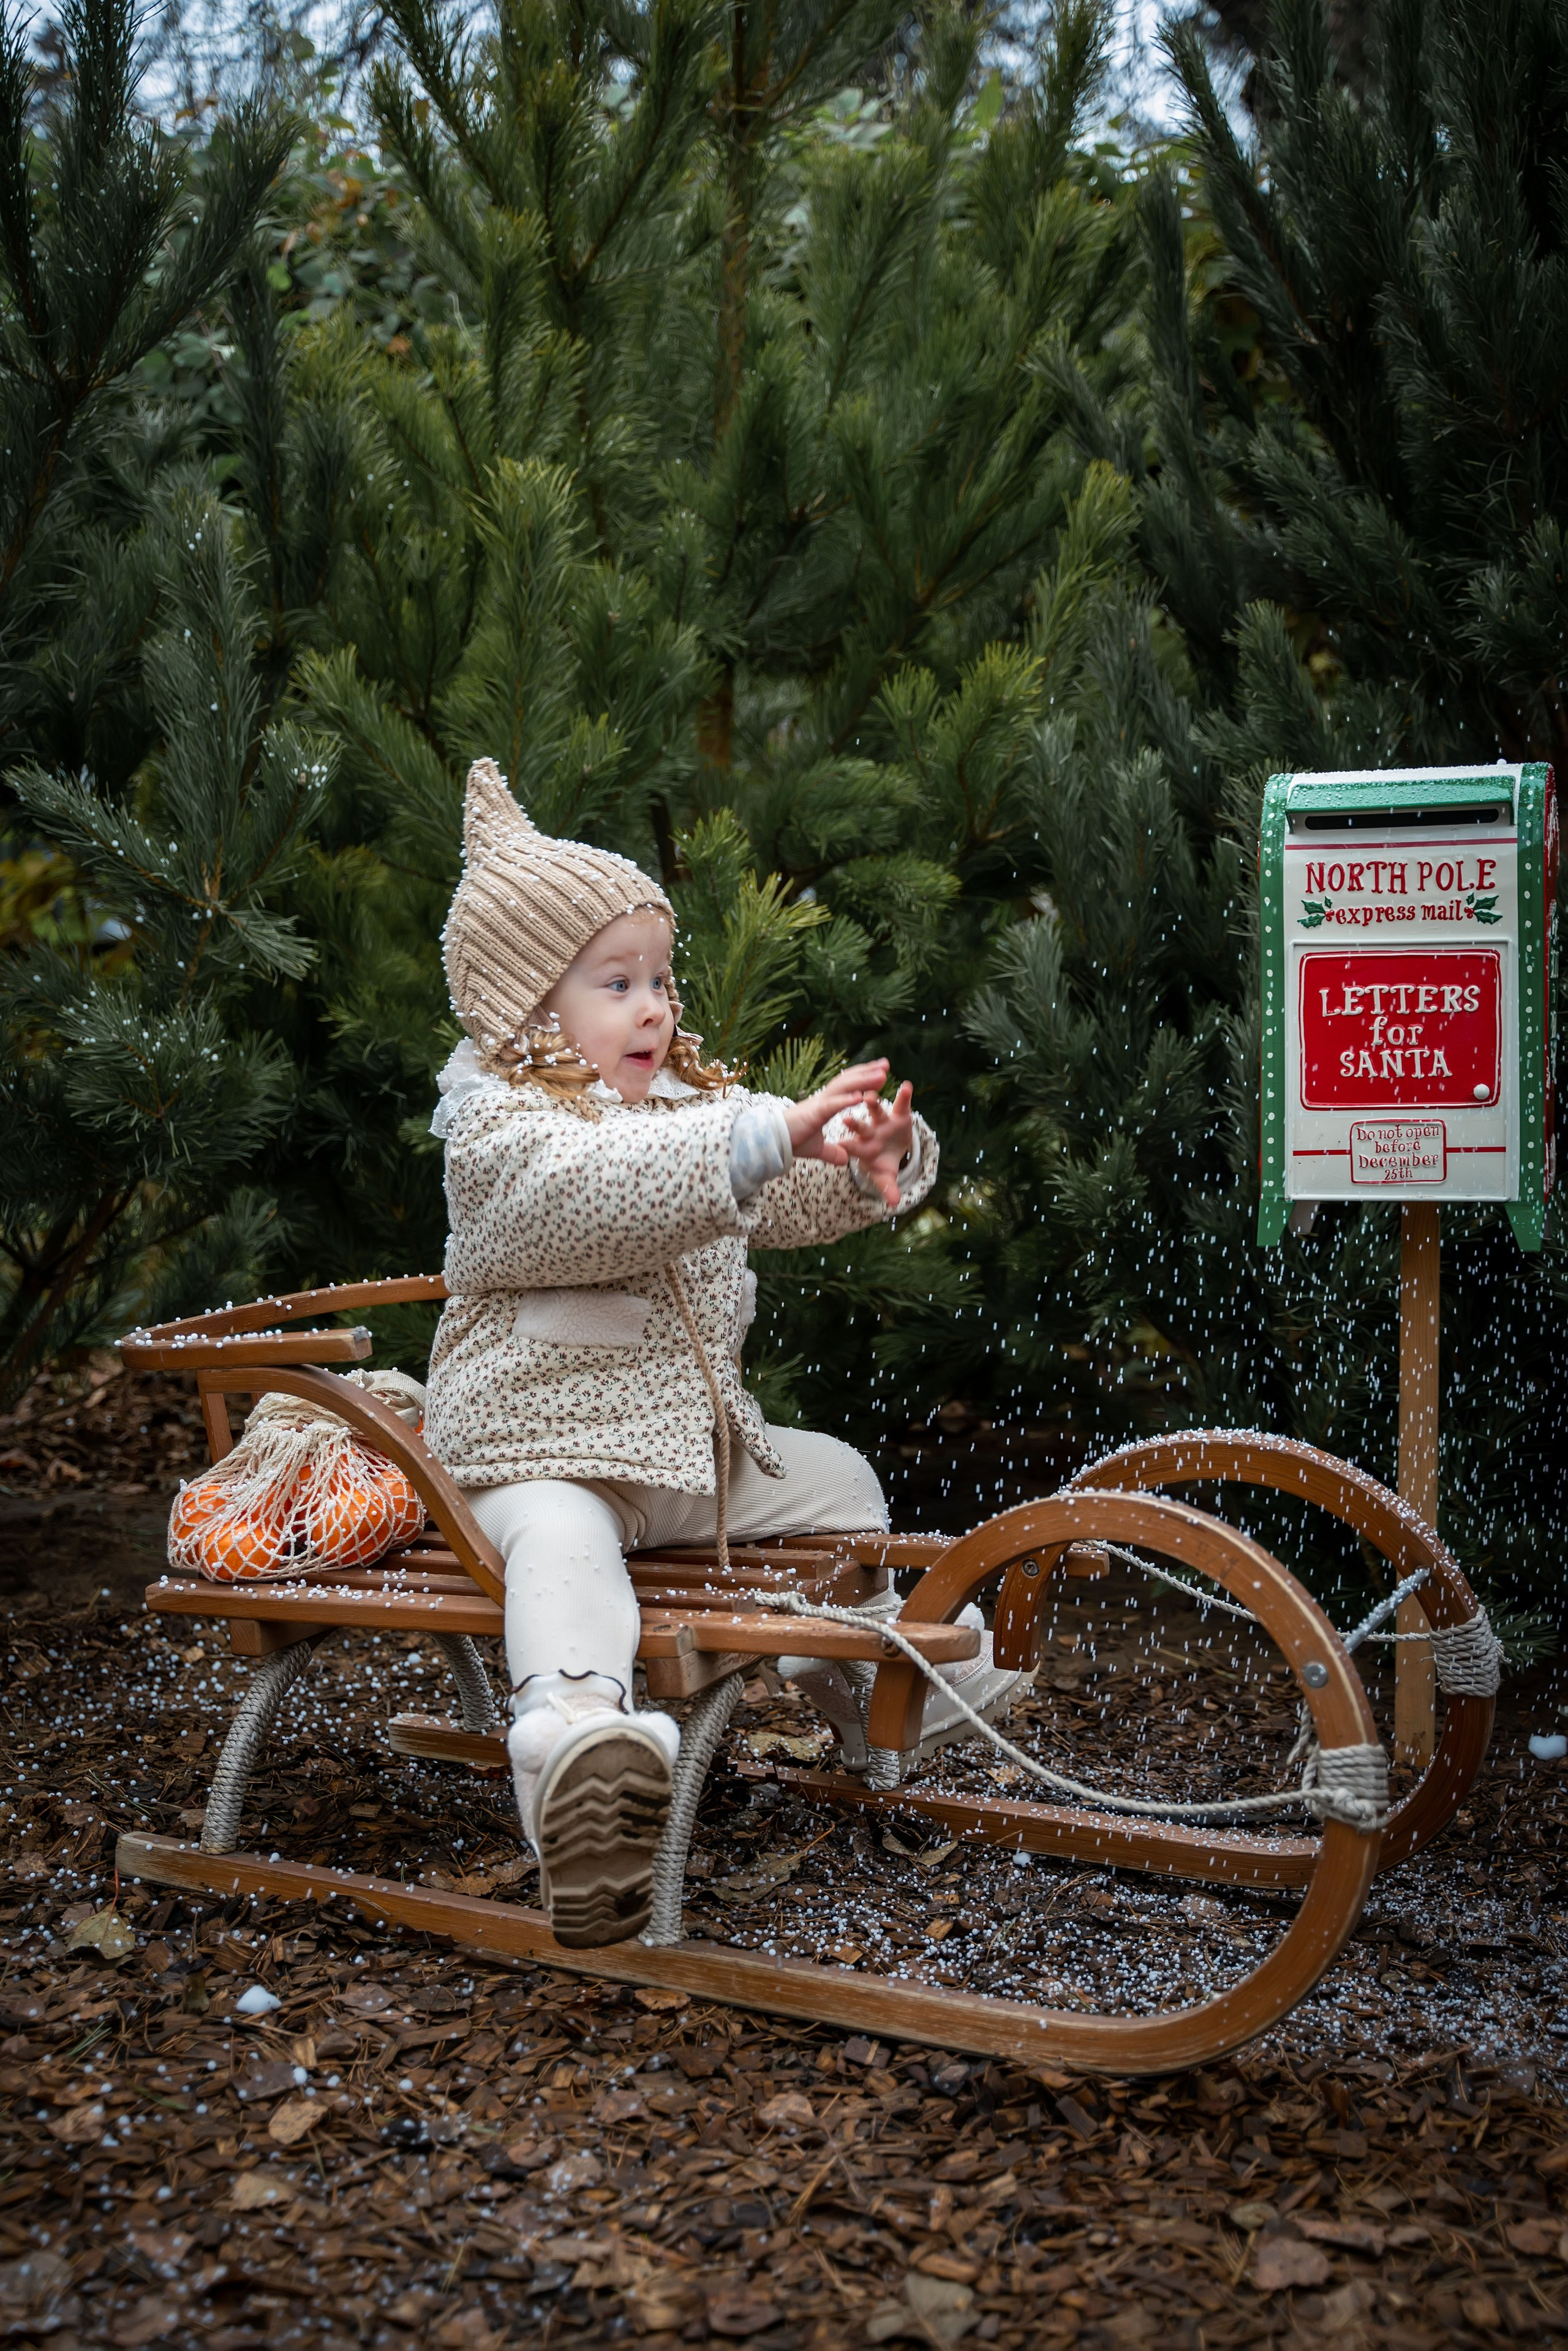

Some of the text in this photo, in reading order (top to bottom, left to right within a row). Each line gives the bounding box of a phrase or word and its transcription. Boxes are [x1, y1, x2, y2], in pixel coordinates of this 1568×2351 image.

[1305, 858, 1496, 894] NORTH POLE
[1335, 900, 1463, 926] express mail
[1319, 984, 1480, 1017] LETTERS
[1368, 1016, 1423, 1046] for
[1340, 1049, 1453, 1079] SANTA
[1357, 1124, 1439, 1141] Do not open
[1375, 1139, 1421, 1153] before
[1359, 1152, 1439, 1169] December
[1384, 1167, 1413, 1180] 25th
